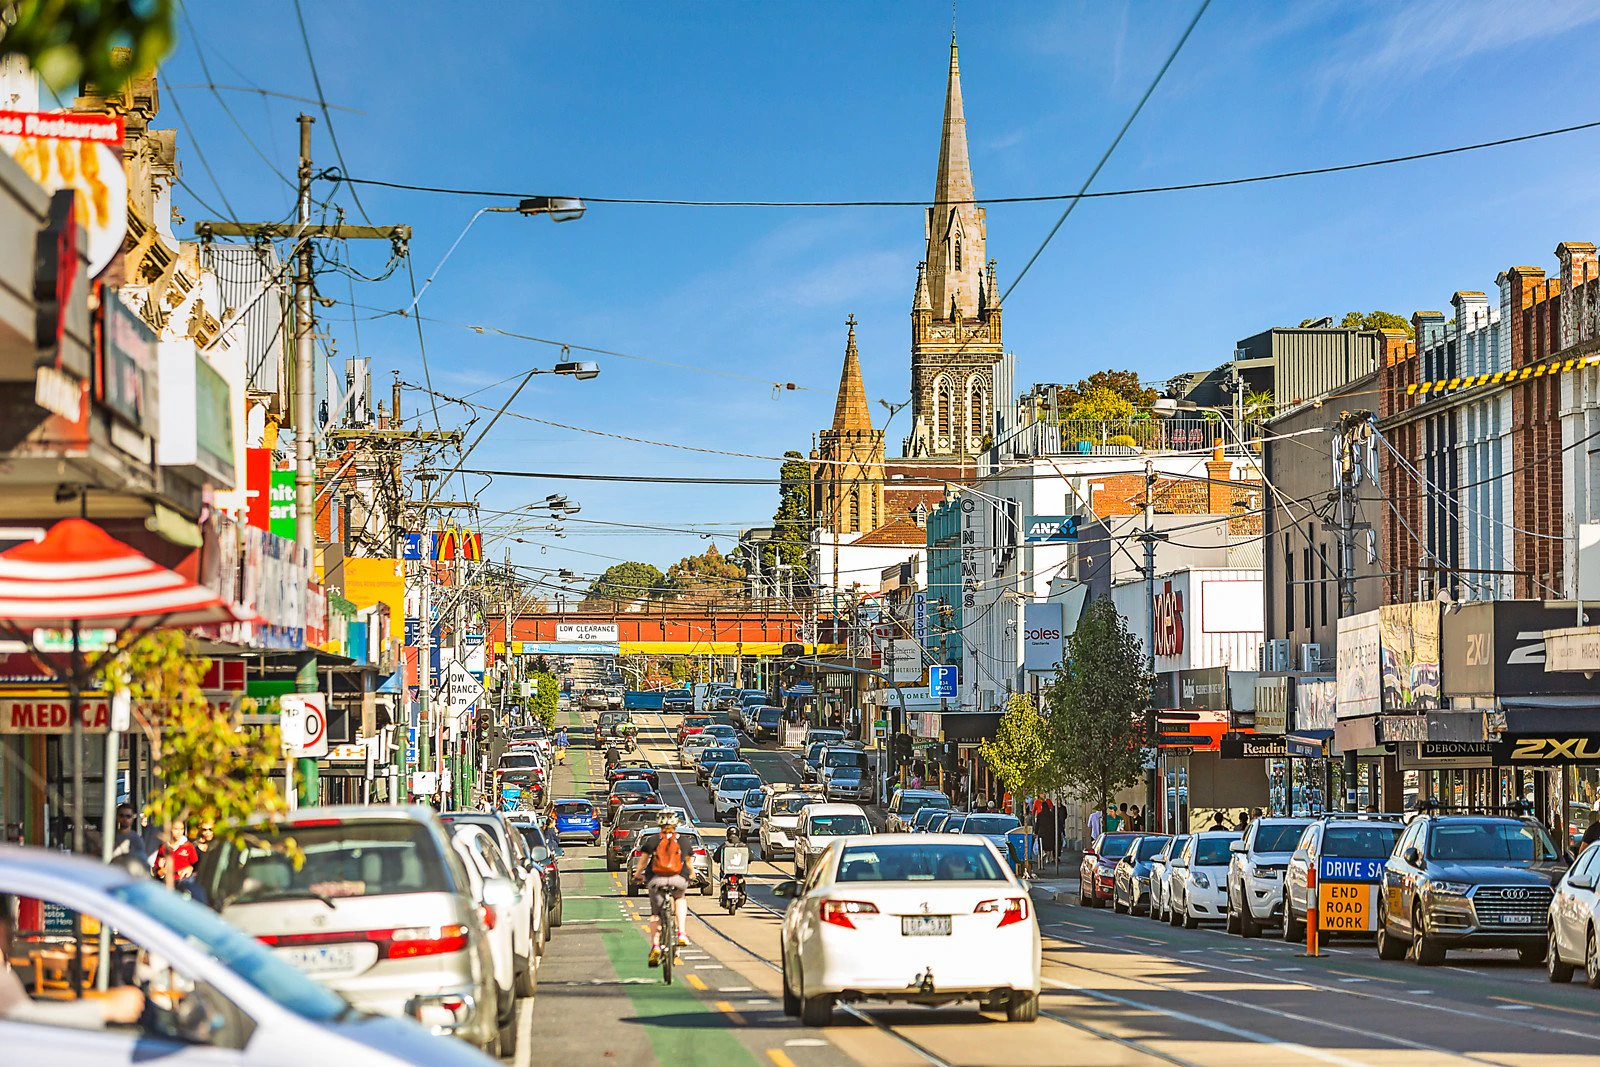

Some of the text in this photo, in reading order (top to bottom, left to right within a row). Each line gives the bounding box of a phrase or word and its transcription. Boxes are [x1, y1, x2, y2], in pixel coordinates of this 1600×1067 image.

[1029, 522, 1061, 535] ANZ
[960, 498, 977, 609] CINEMAS
[575, 625, 615, 633] CLEARANCE
[1024, 627, 1060, 640] coles
[1466, 633, 1491, 666] 2XU
[939, 668, 949, 680] P
[11, 703, 110, 728] MEDICA
[1426, 743, 1493, 753] DEBONAIRE
[1511, 738, 1600, 759] 2XU
[1326, 861, 1383, 878] DRIVE SA
[1331, 886, 1358, 899] END
[1326, 901, 1363, 914] ROAD
[1326, 916, 1362, 929] WORK
